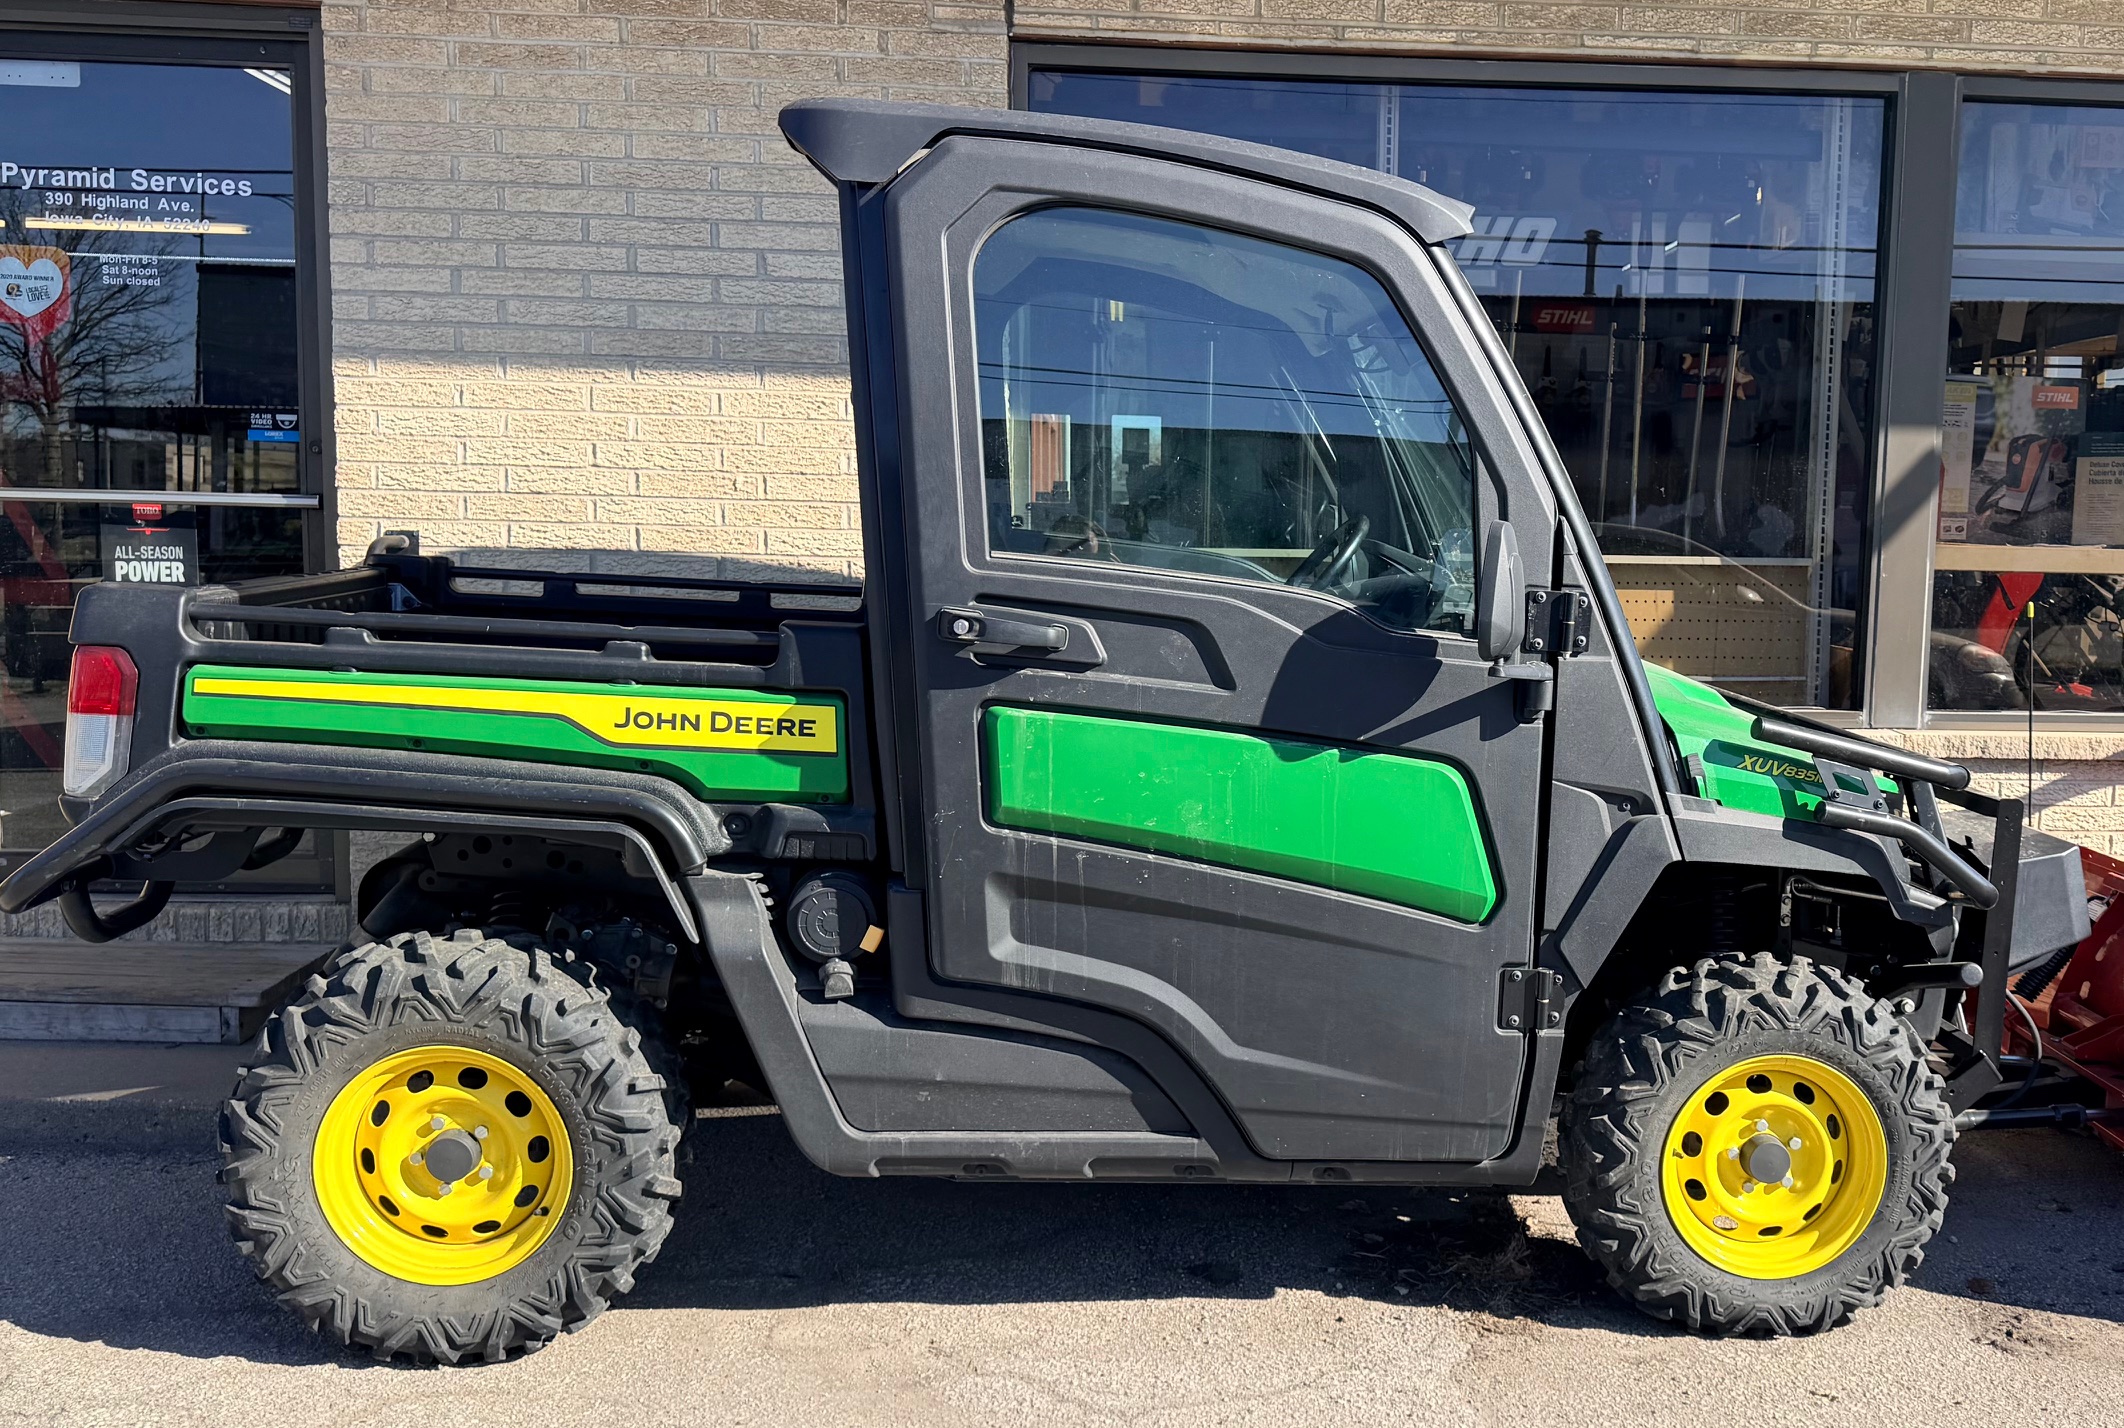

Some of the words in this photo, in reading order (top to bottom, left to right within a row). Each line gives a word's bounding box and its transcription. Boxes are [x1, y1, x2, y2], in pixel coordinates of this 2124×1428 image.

[1, 162, 116, 190] Pyramid
[131, 169, 253, 197] Services
[45, 192, 73, 206] 390
[81, 193, 149, 212] Highland
[157, 198, 195, 213] Ave.
[45, 211, 84, 225] Iowa
[92, 213, 129, 230] City,
[137, 216, 154, 229] IA
[164, 217, 212, 232] 52240
[1446, 216, 1558, 267] HO
[99, 255, 140, 266] Mon-Fri
[142, 256, 158, 266] 8-5
[102, 266, 120, 276] Sat
[121, 266, 158, 276] 8-noon
[102, 276, 123, 286] Sun
[125, 276, 161, 287] closed
[1537, 308, 1593, 326] STIHL
[2036, 391, 2074, 403] STIHL
[114, 545, 184, 560] ALL-SEASON
[114, 560, 186, 583] POWER
[613, 706, 701, 732] JOHN
[710, 710, 817, 738] DEERE
[444, 1024, 481, 1039] RADIAL
